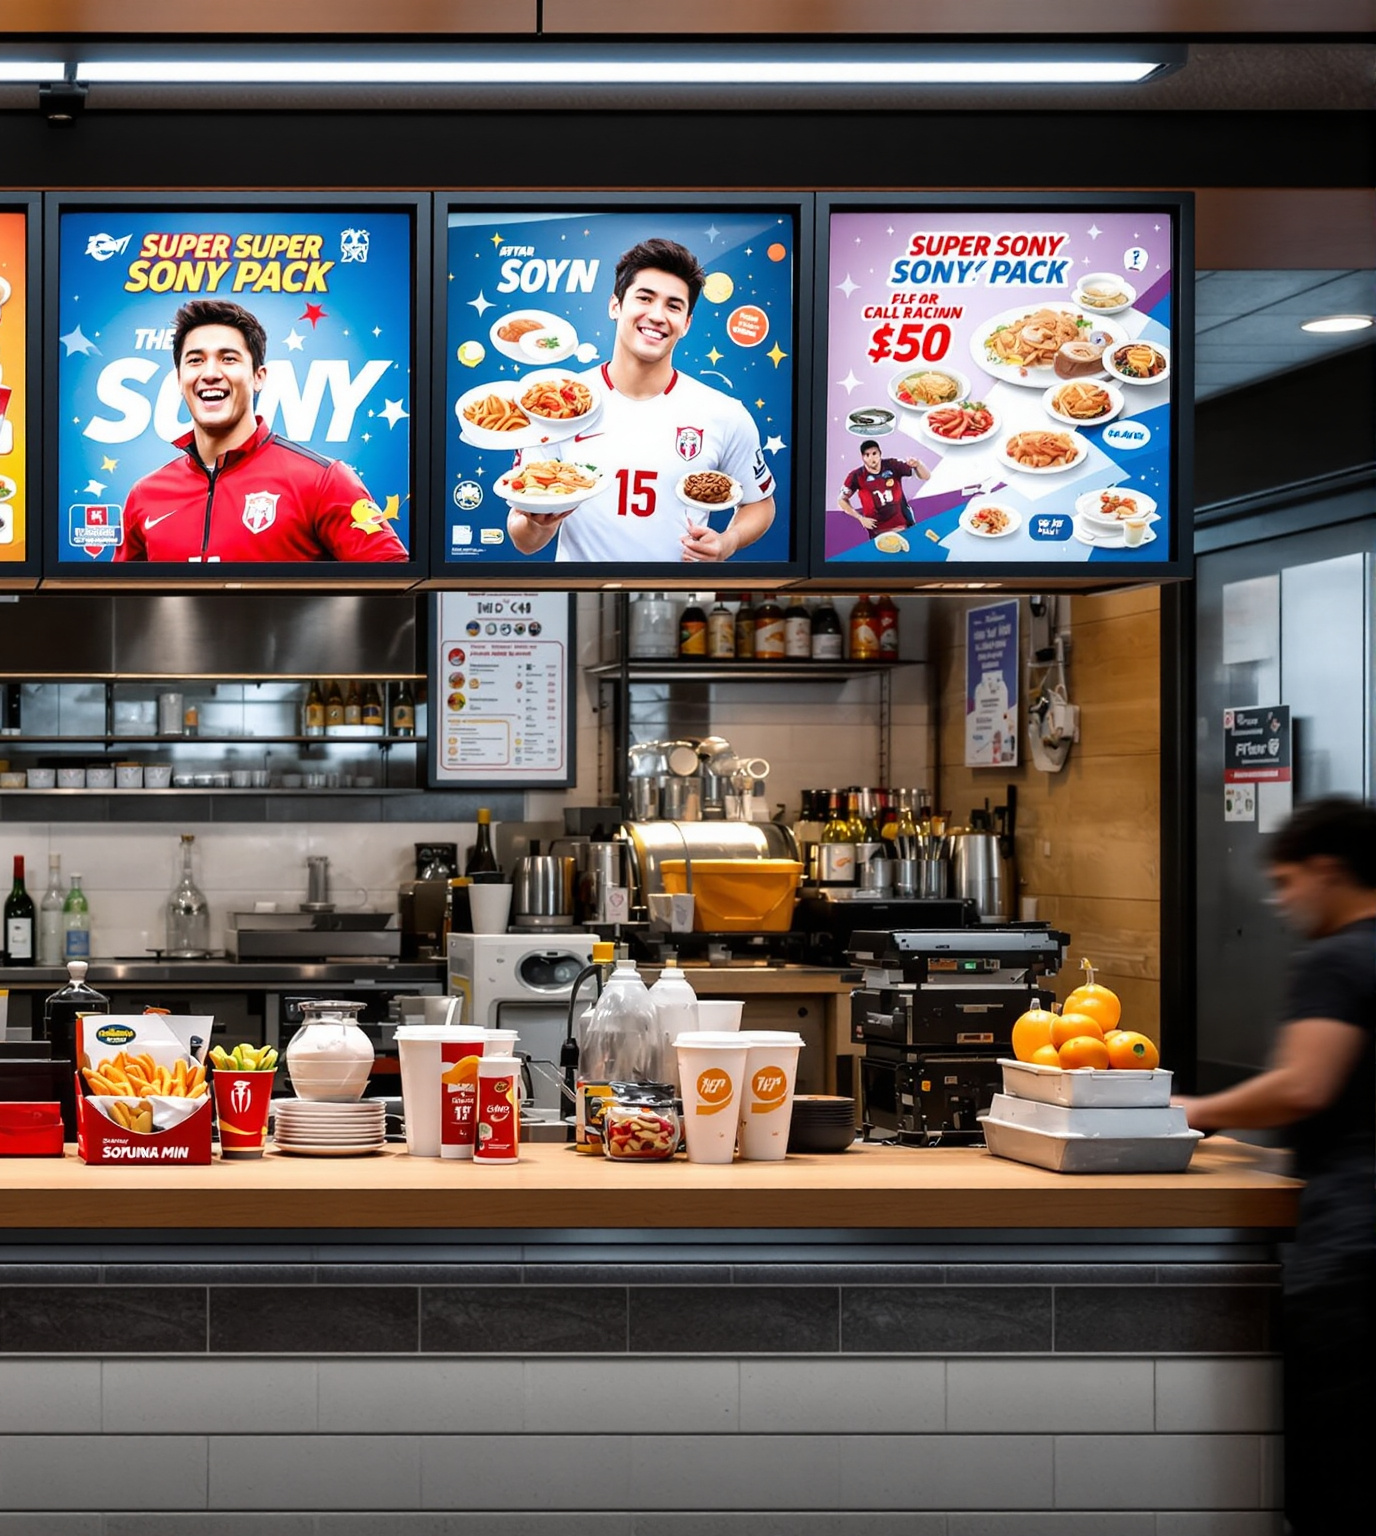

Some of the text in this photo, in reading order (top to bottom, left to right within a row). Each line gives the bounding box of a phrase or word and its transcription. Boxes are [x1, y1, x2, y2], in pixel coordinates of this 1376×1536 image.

[140, 233, 324, 259] SUPER SUPER
[909, 235, 1065, 257] SUPER SONY
[124, 261, 335, 293] SONY PACK
[496, 258, 600, 294] SOYN
[989, 260, 1069, 285] PACK
[864, 307, 900, 319] CALL
[134, 328, 176, 350] THE
[868, 323, 952, 363] $50
[615, 468, 658, 517] 15
[161, 1146, 189, 1158] MIN
